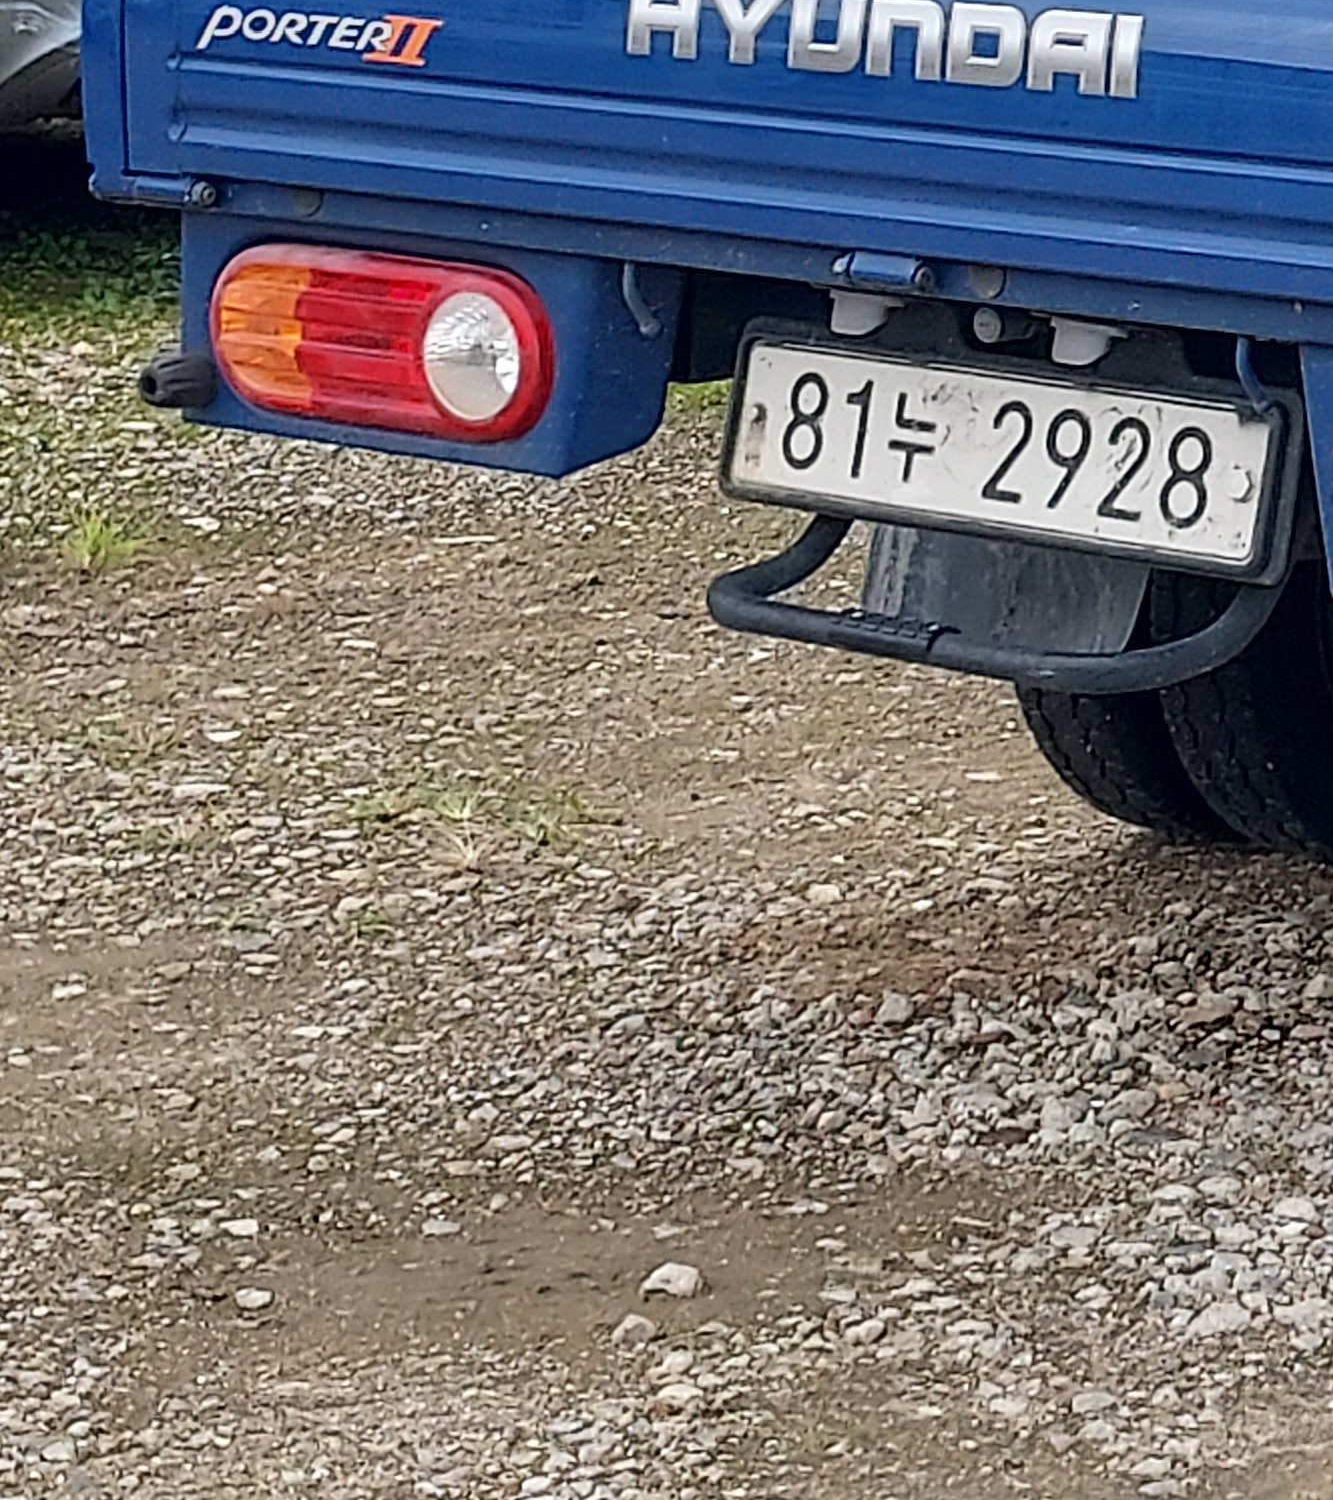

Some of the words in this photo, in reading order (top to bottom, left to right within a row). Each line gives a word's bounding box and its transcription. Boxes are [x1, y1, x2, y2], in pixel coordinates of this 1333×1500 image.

[195, 4, 394, 52] PORTER
[781, 371, 938, 483] 81누
[980, 400, 1213, 530] 2928
